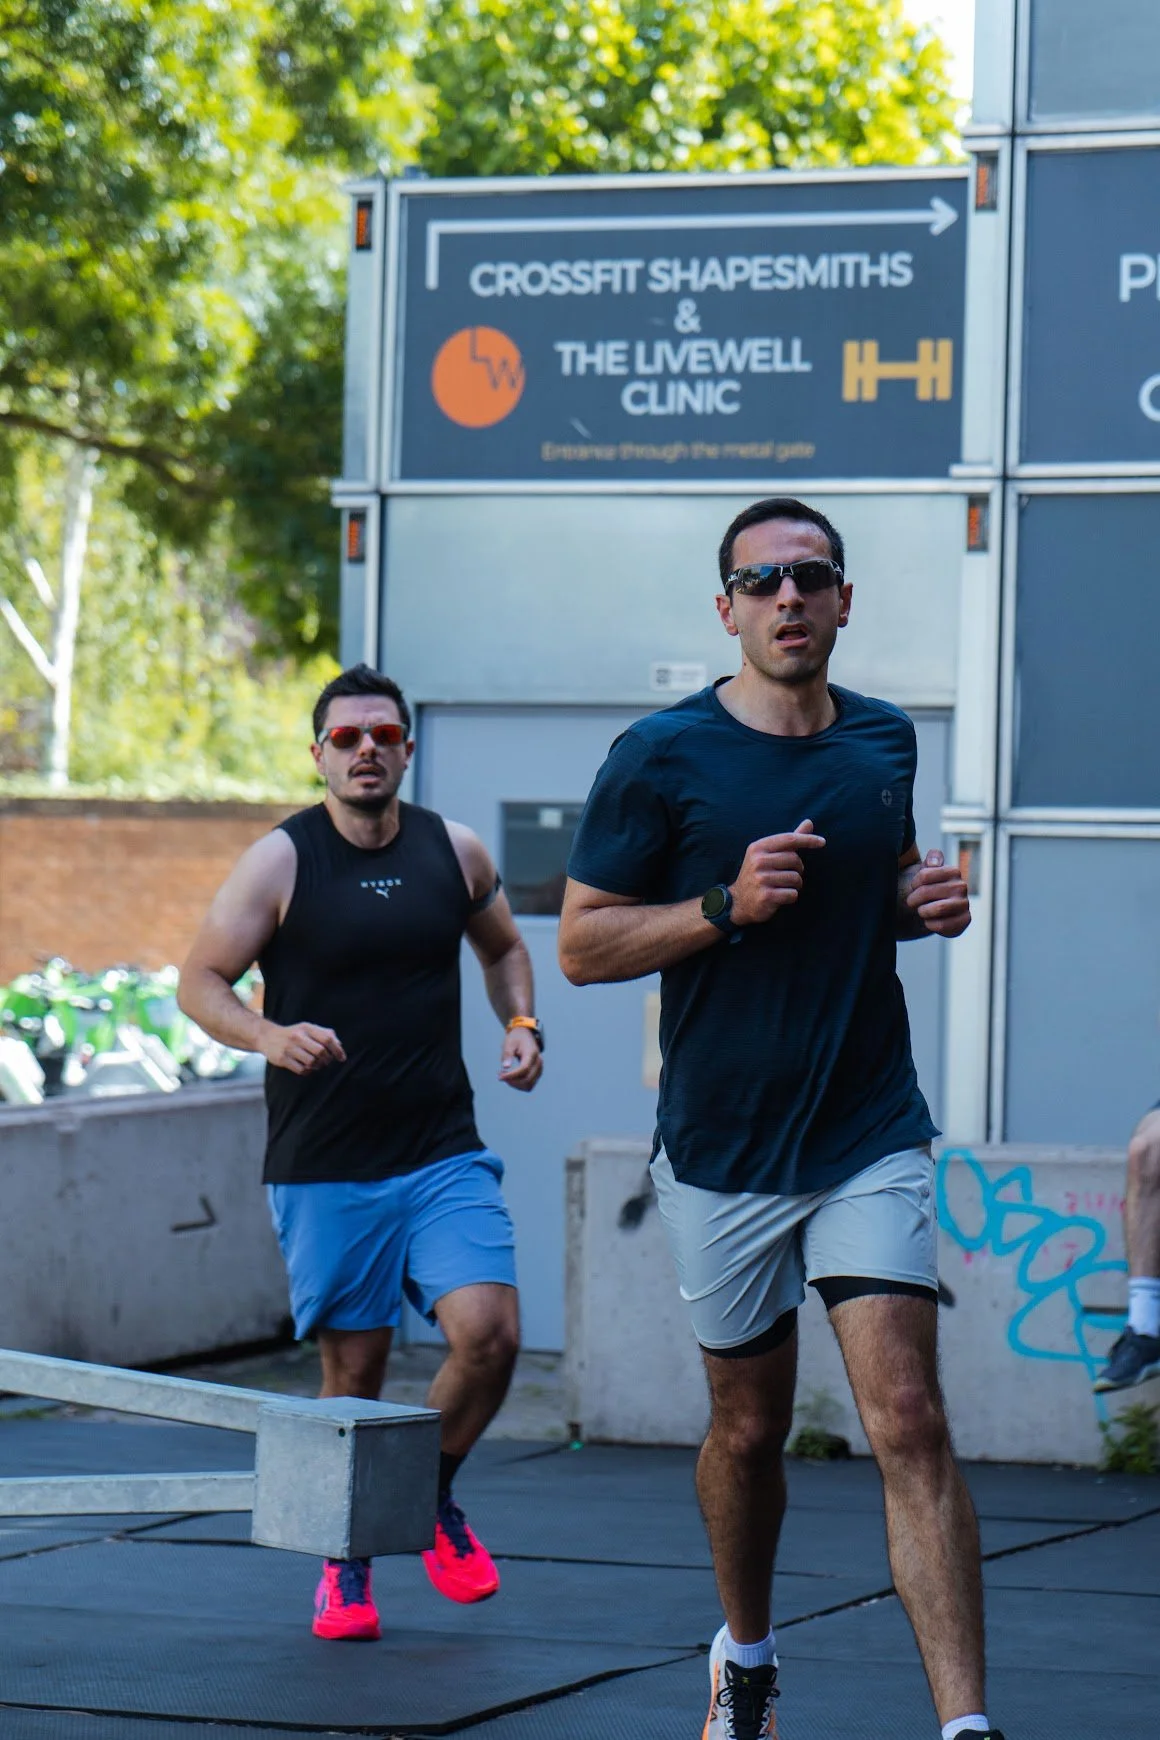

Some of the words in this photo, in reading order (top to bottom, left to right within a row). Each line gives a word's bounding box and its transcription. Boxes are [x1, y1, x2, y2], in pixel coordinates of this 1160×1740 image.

[469, 259, 645, 297] CROSSFIT
[646, 251, 914, 293] SHAPESMITHS
[1118, 253, 1160, 302] P
[674, 298, 702, 334] &
[554, 340, 629, 376] THE
[635, 337, 813, 374] LIVEWELL
[620, 379, 742, 416] CLINIC
[619, 441, 689, 464] through
[691, 441, 719, 460] the
[722, 441, 774, 460] metal
[776, 442, 816, 464] gate
